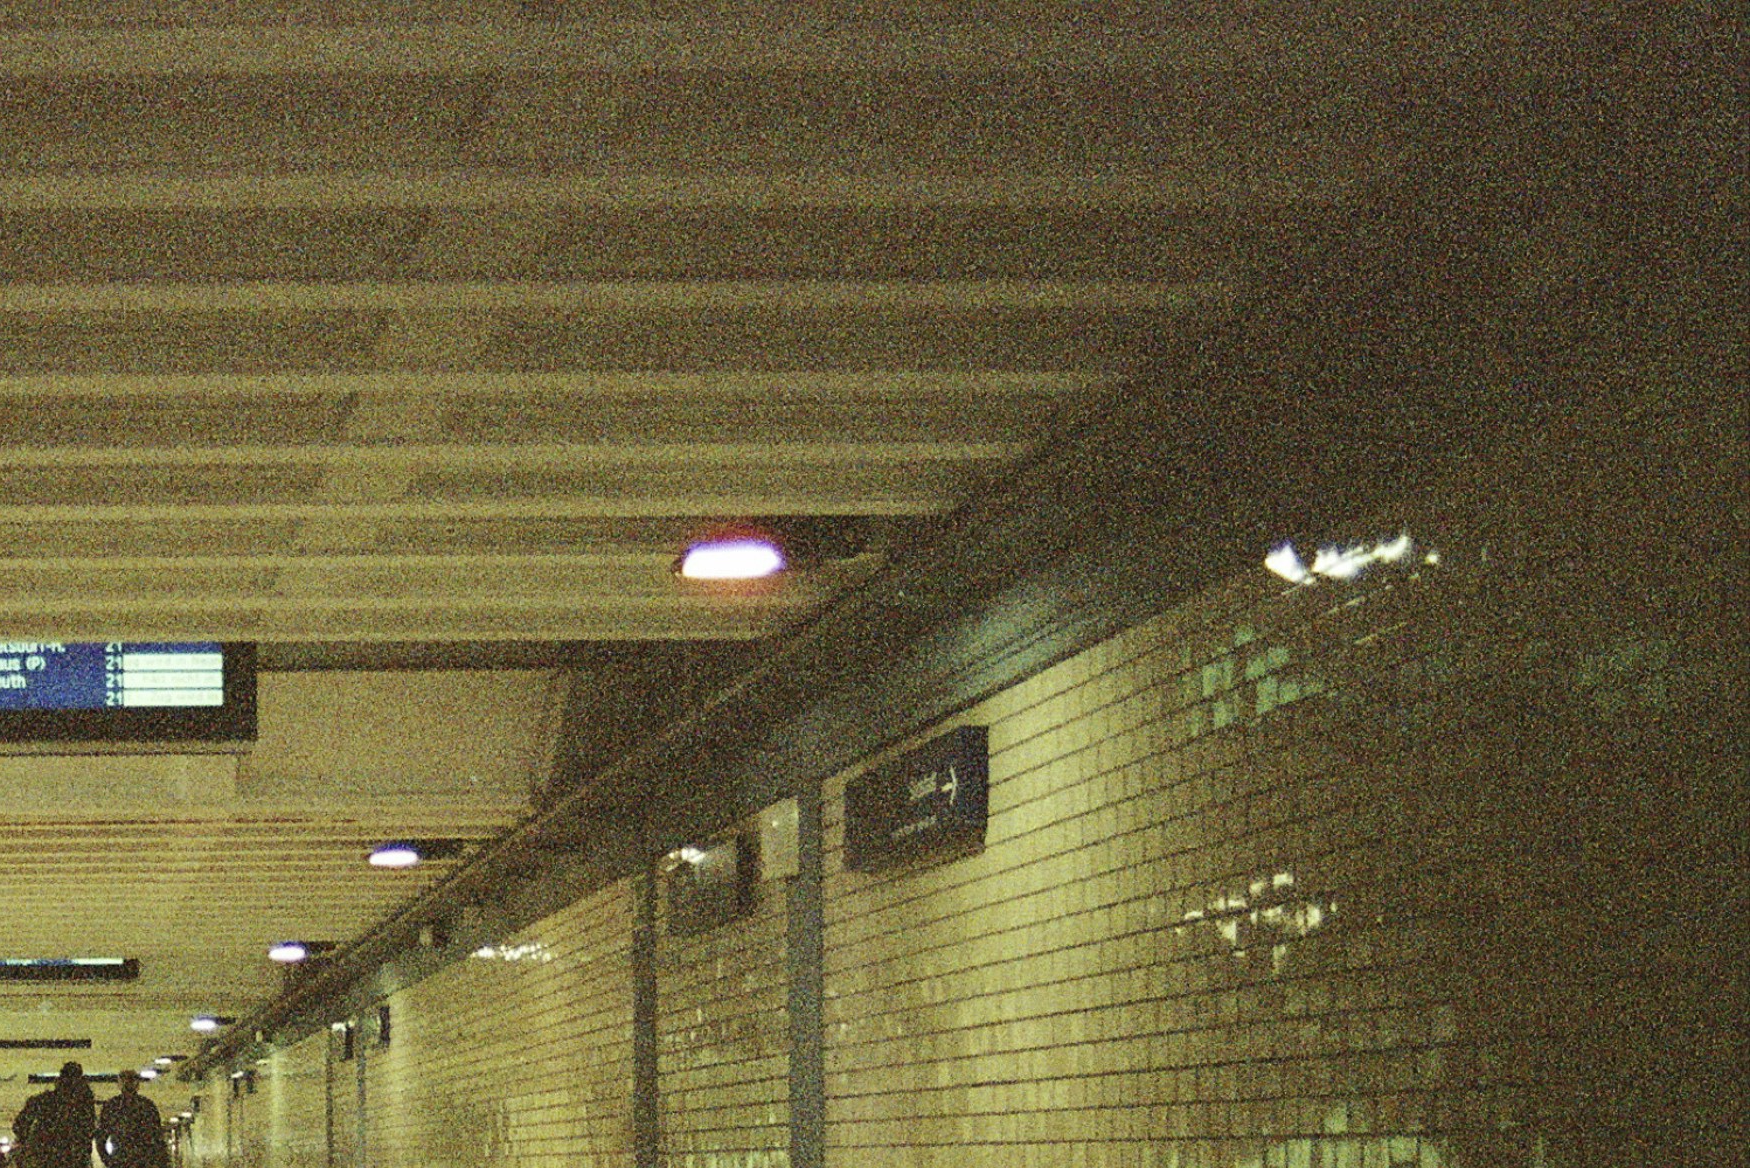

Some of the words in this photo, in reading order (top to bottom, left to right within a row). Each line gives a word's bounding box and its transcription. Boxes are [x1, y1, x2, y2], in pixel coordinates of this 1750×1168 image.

[26, 656, 46, 671] (P)
[105, 656, 123, 671] 21
[105, 673, 123, 689] 21
[105, 691, 123, 707] 21
